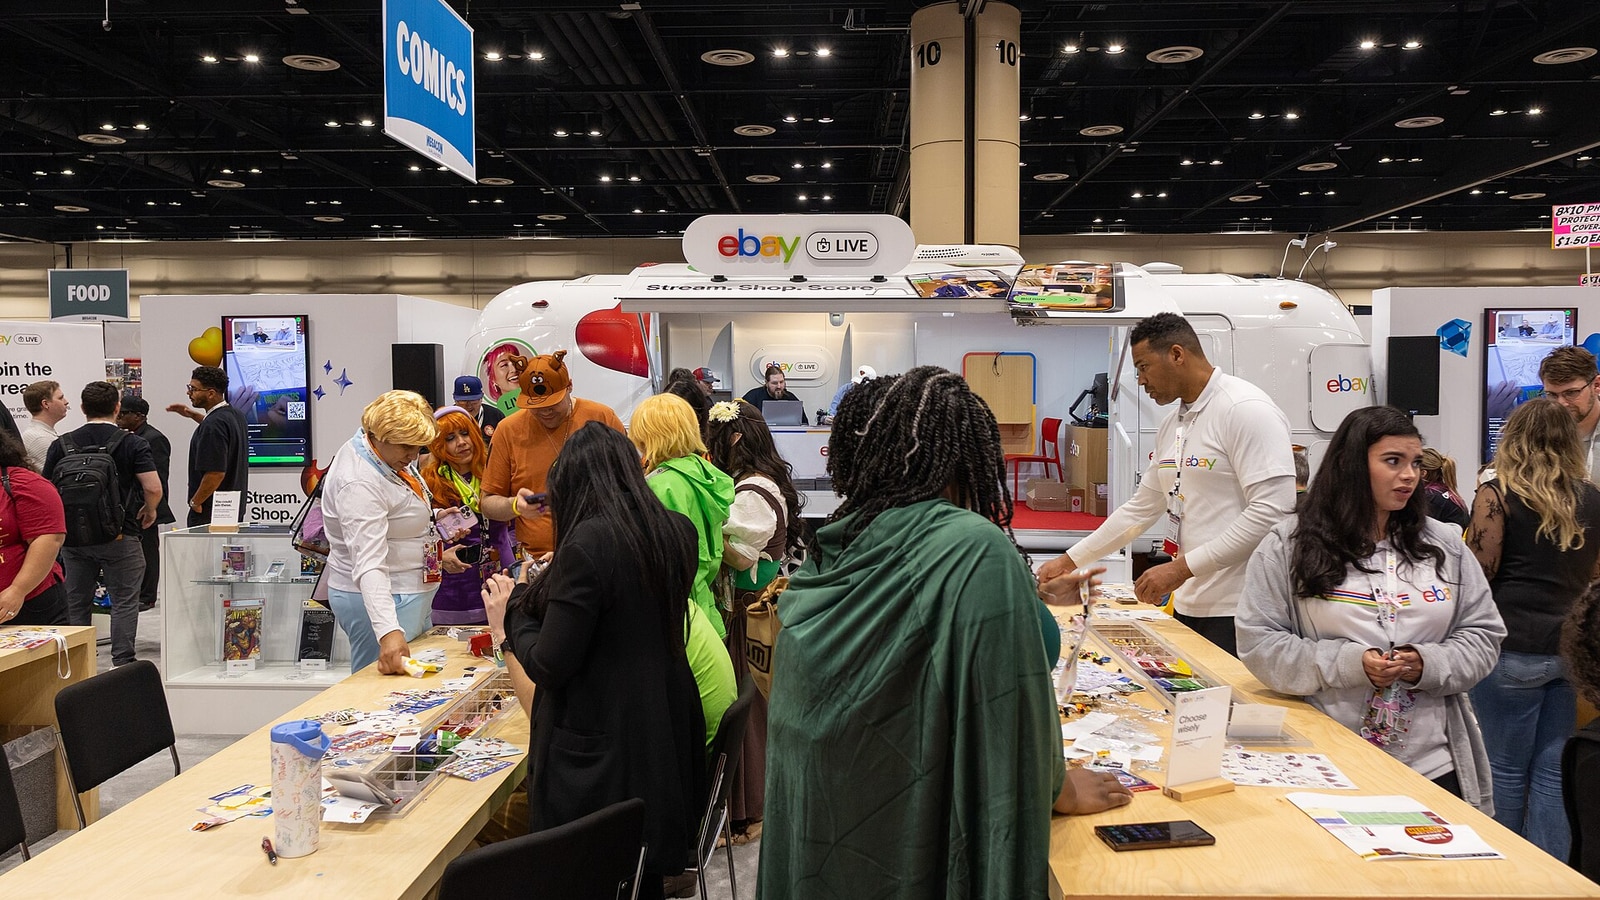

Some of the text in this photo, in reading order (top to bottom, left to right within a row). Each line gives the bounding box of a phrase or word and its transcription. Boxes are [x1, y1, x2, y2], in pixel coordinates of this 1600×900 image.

[917, 39, 1017, 68] 10 10
[397, 20, 467, 117] COMICS
[1555, 205, 1584, 217] 8X10
[718, 228, 868, 263] ebay LIVE
[67, 284, 111, 302] FOOD
[738, 284, 802, 292] Shop.
[24, 362, 52, 376] the
[766, 360, 794, 372] ebay
[1326, 374, 1368, 395] ebay
[1185, 454, 1217, 470] ebay
[246, 490, 301, 504] Stream.
[251, 507, 294, 523] Shop.
[1422, 585, 1452, 602] eba
[1179, 713, 1207, 724] Choose
[1177, 723, 1200, 733] wisely
